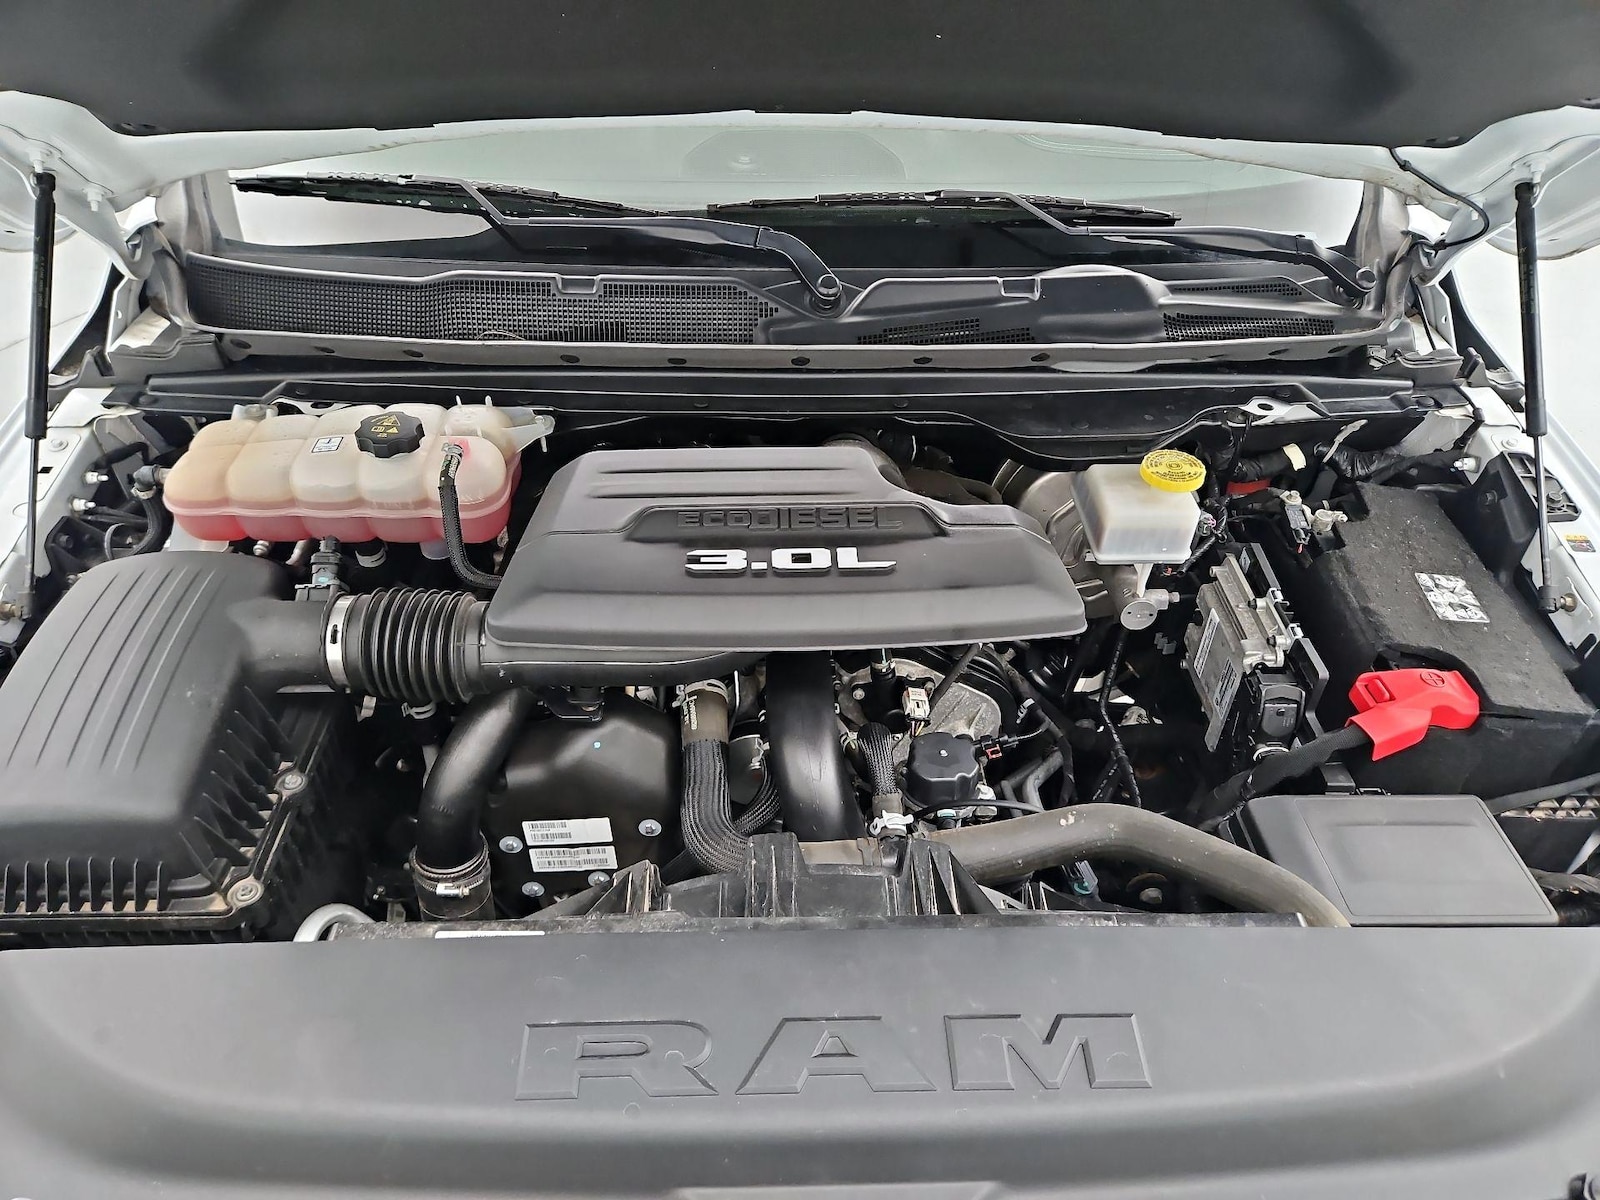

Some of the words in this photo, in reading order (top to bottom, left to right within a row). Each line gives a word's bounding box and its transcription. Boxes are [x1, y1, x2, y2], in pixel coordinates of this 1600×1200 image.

[678, 507, 904, 531] ECODIESEL
[684, 547, 897, 573] 3.0L
[514, 1012, 1153, 1100] RAM
